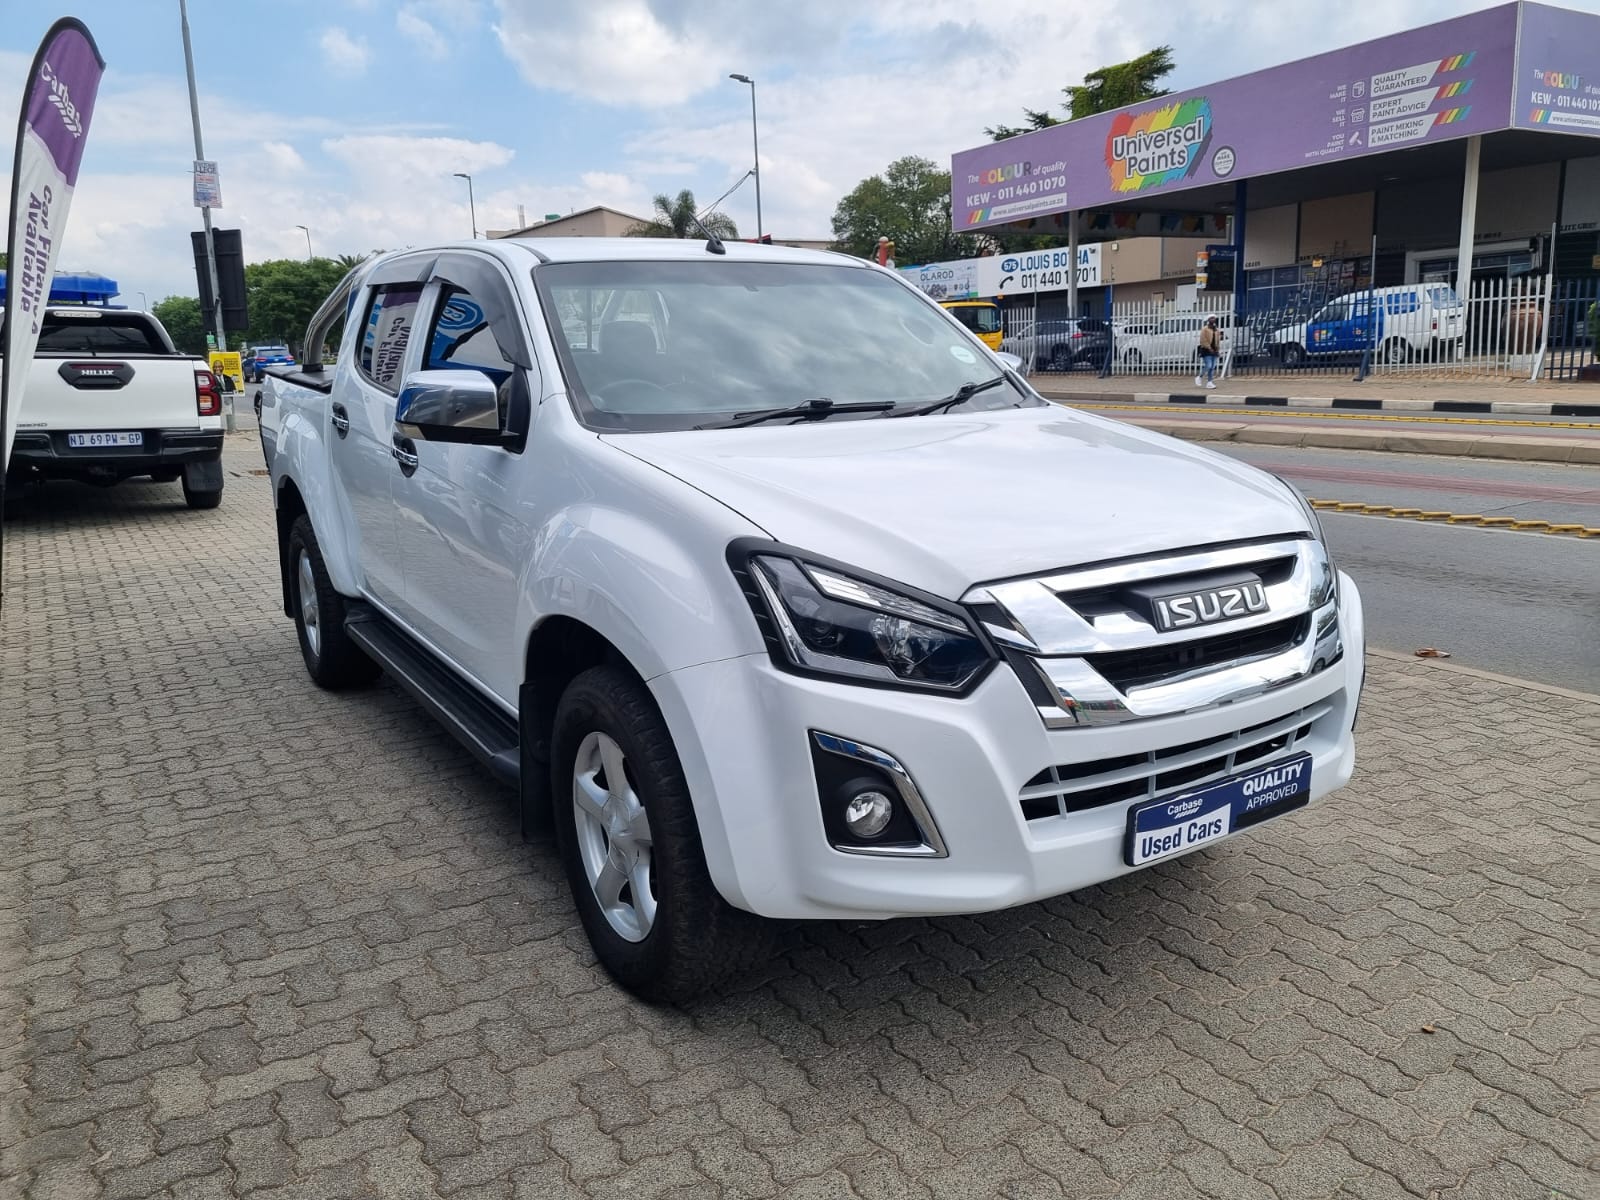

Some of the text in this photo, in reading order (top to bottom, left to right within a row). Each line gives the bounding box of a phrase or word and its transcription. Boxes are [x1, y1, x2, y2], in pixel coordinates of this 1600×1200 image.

[1373, 76, 1427, 93] GUARANTEED
[1374, 71, 1407, 86] QUALITY
[1372, 98, 1402, 111] EXPERT
[1372, 101, 1426, 118] PAINT ADVICE
[1531, 91, 1551, 105] KEW
[1557, 95, 1570, 107] 011
[1571, 97, 1587, 109] 440
[1113, 117, 1202, 158] Universal
[1371, 120, 1424, 135] PAINT MIXING
[1377, 129, 1419, 142] MATCHING
[1127, 147, 1187, 176] Paints
[968, 161, 1067, 186] The COLOUR of quality
[967, 192, 990, 207] KEW
[998, 187, 1013, 200] 011
[1016, 182, 1036, 196] 440
[1039, 175, 1066, 191] 1070
[41, 185, 52, 230] Car
[21, 191, 42, 313] Available
[1003, 249, 1089, 272] 575 LOUIS BOHA
[1021, 273, 1037, 288] 011
[1040, 271, 1062, 286] 440
[70, 433, 141, 446] ND 69 PW GP
[1158, 583, 1266, 628] ISUZU
[1242, 762, 1303, 796] QUALITY
[1167, 798, 1203, 815] Carbase
[1246, 782, 1298, 811] APPROVED
[1141, 818, 1222, 859] Used Cars
